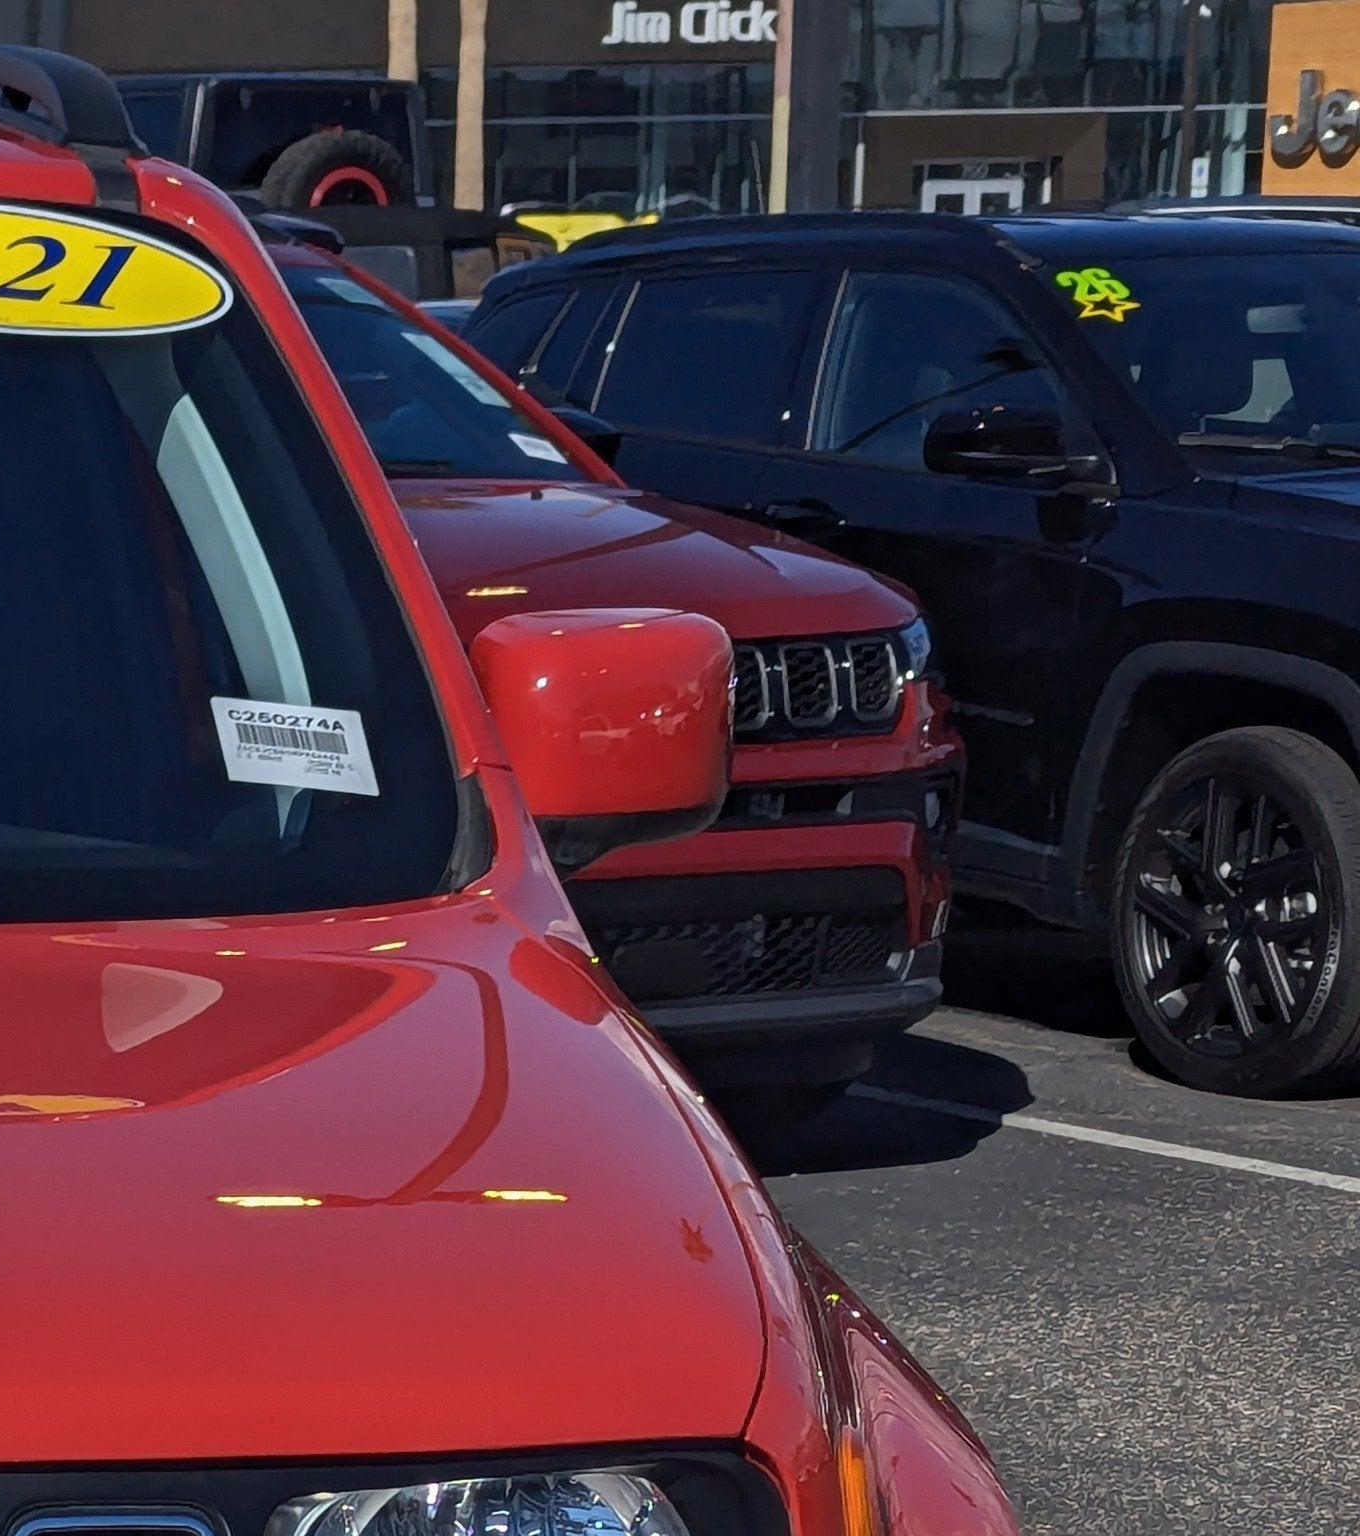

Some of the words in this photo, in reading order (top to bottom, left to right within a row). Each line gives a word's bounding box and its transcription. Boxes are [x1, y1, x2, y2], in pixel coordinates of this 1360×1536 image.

[602, 1, 670, 44] Jim
[680, 0, 777, 43] Click
[1056, 267, 1130, 302] 26
